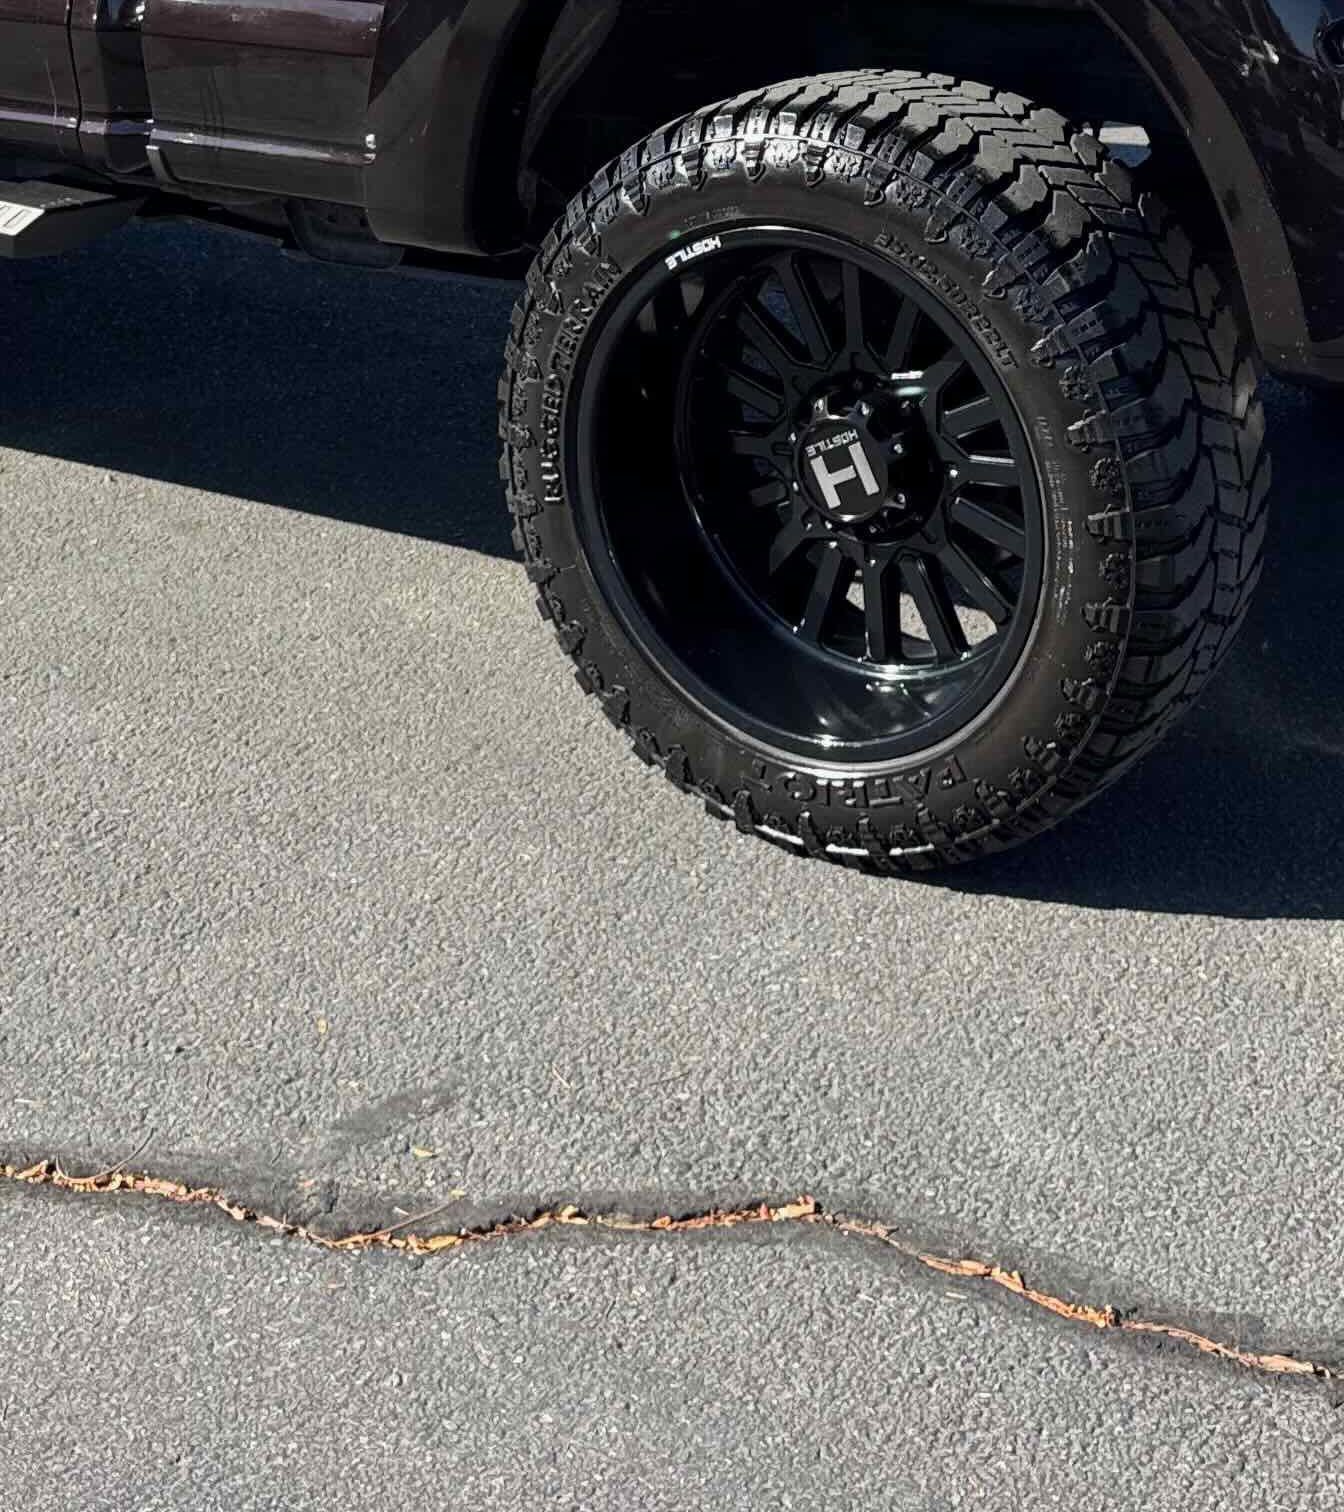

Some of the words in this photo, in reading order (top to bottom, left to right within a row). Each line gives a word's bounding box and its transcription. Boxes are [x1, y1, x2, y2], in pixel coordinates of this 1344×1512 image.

[665, 235, 722, 270] HOSTILE
[805, 429, 858, 457] HOSTILE
[810, 441, 880, 509] H
